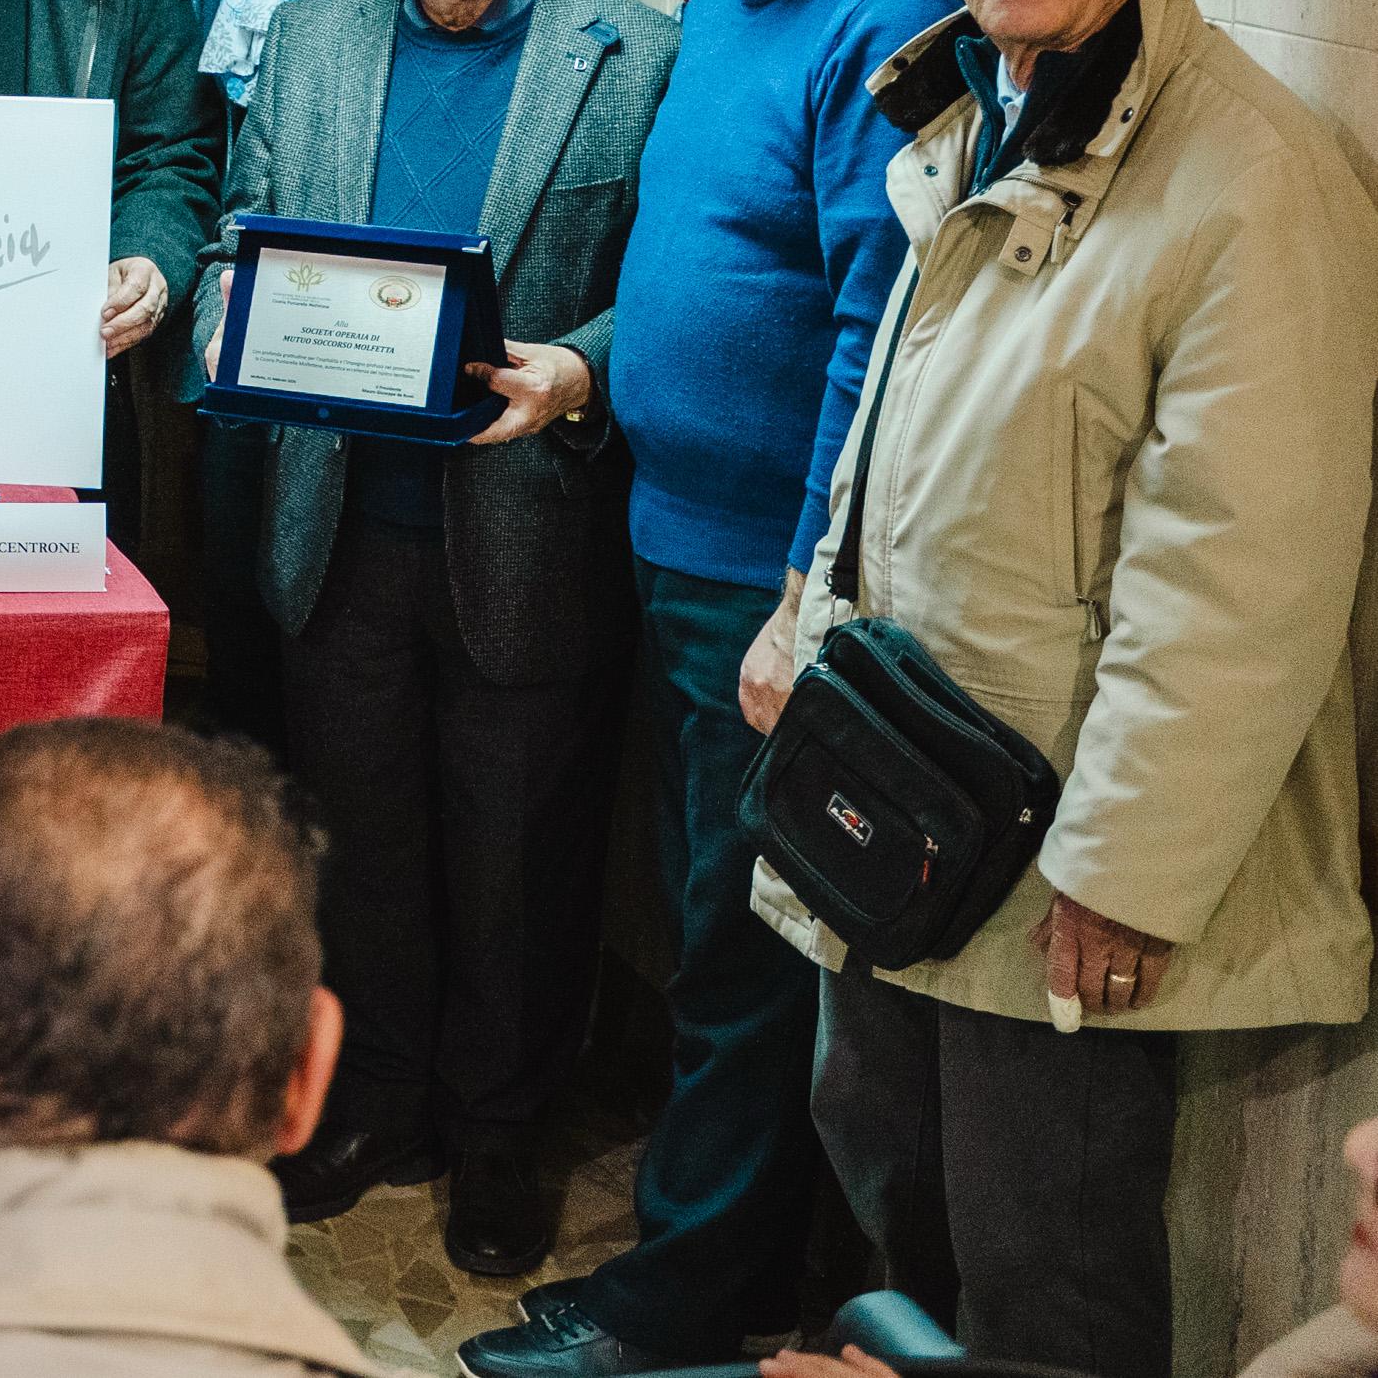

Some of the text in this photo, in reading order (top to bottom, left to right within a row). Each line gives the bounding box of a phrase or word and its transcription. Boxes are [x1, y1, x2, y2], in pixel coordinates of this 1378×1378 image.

[335, 330, 369, 341] OPERAIA
[283, 335, 395, 354] MUTUO SOCCORSO MOLFETTA
